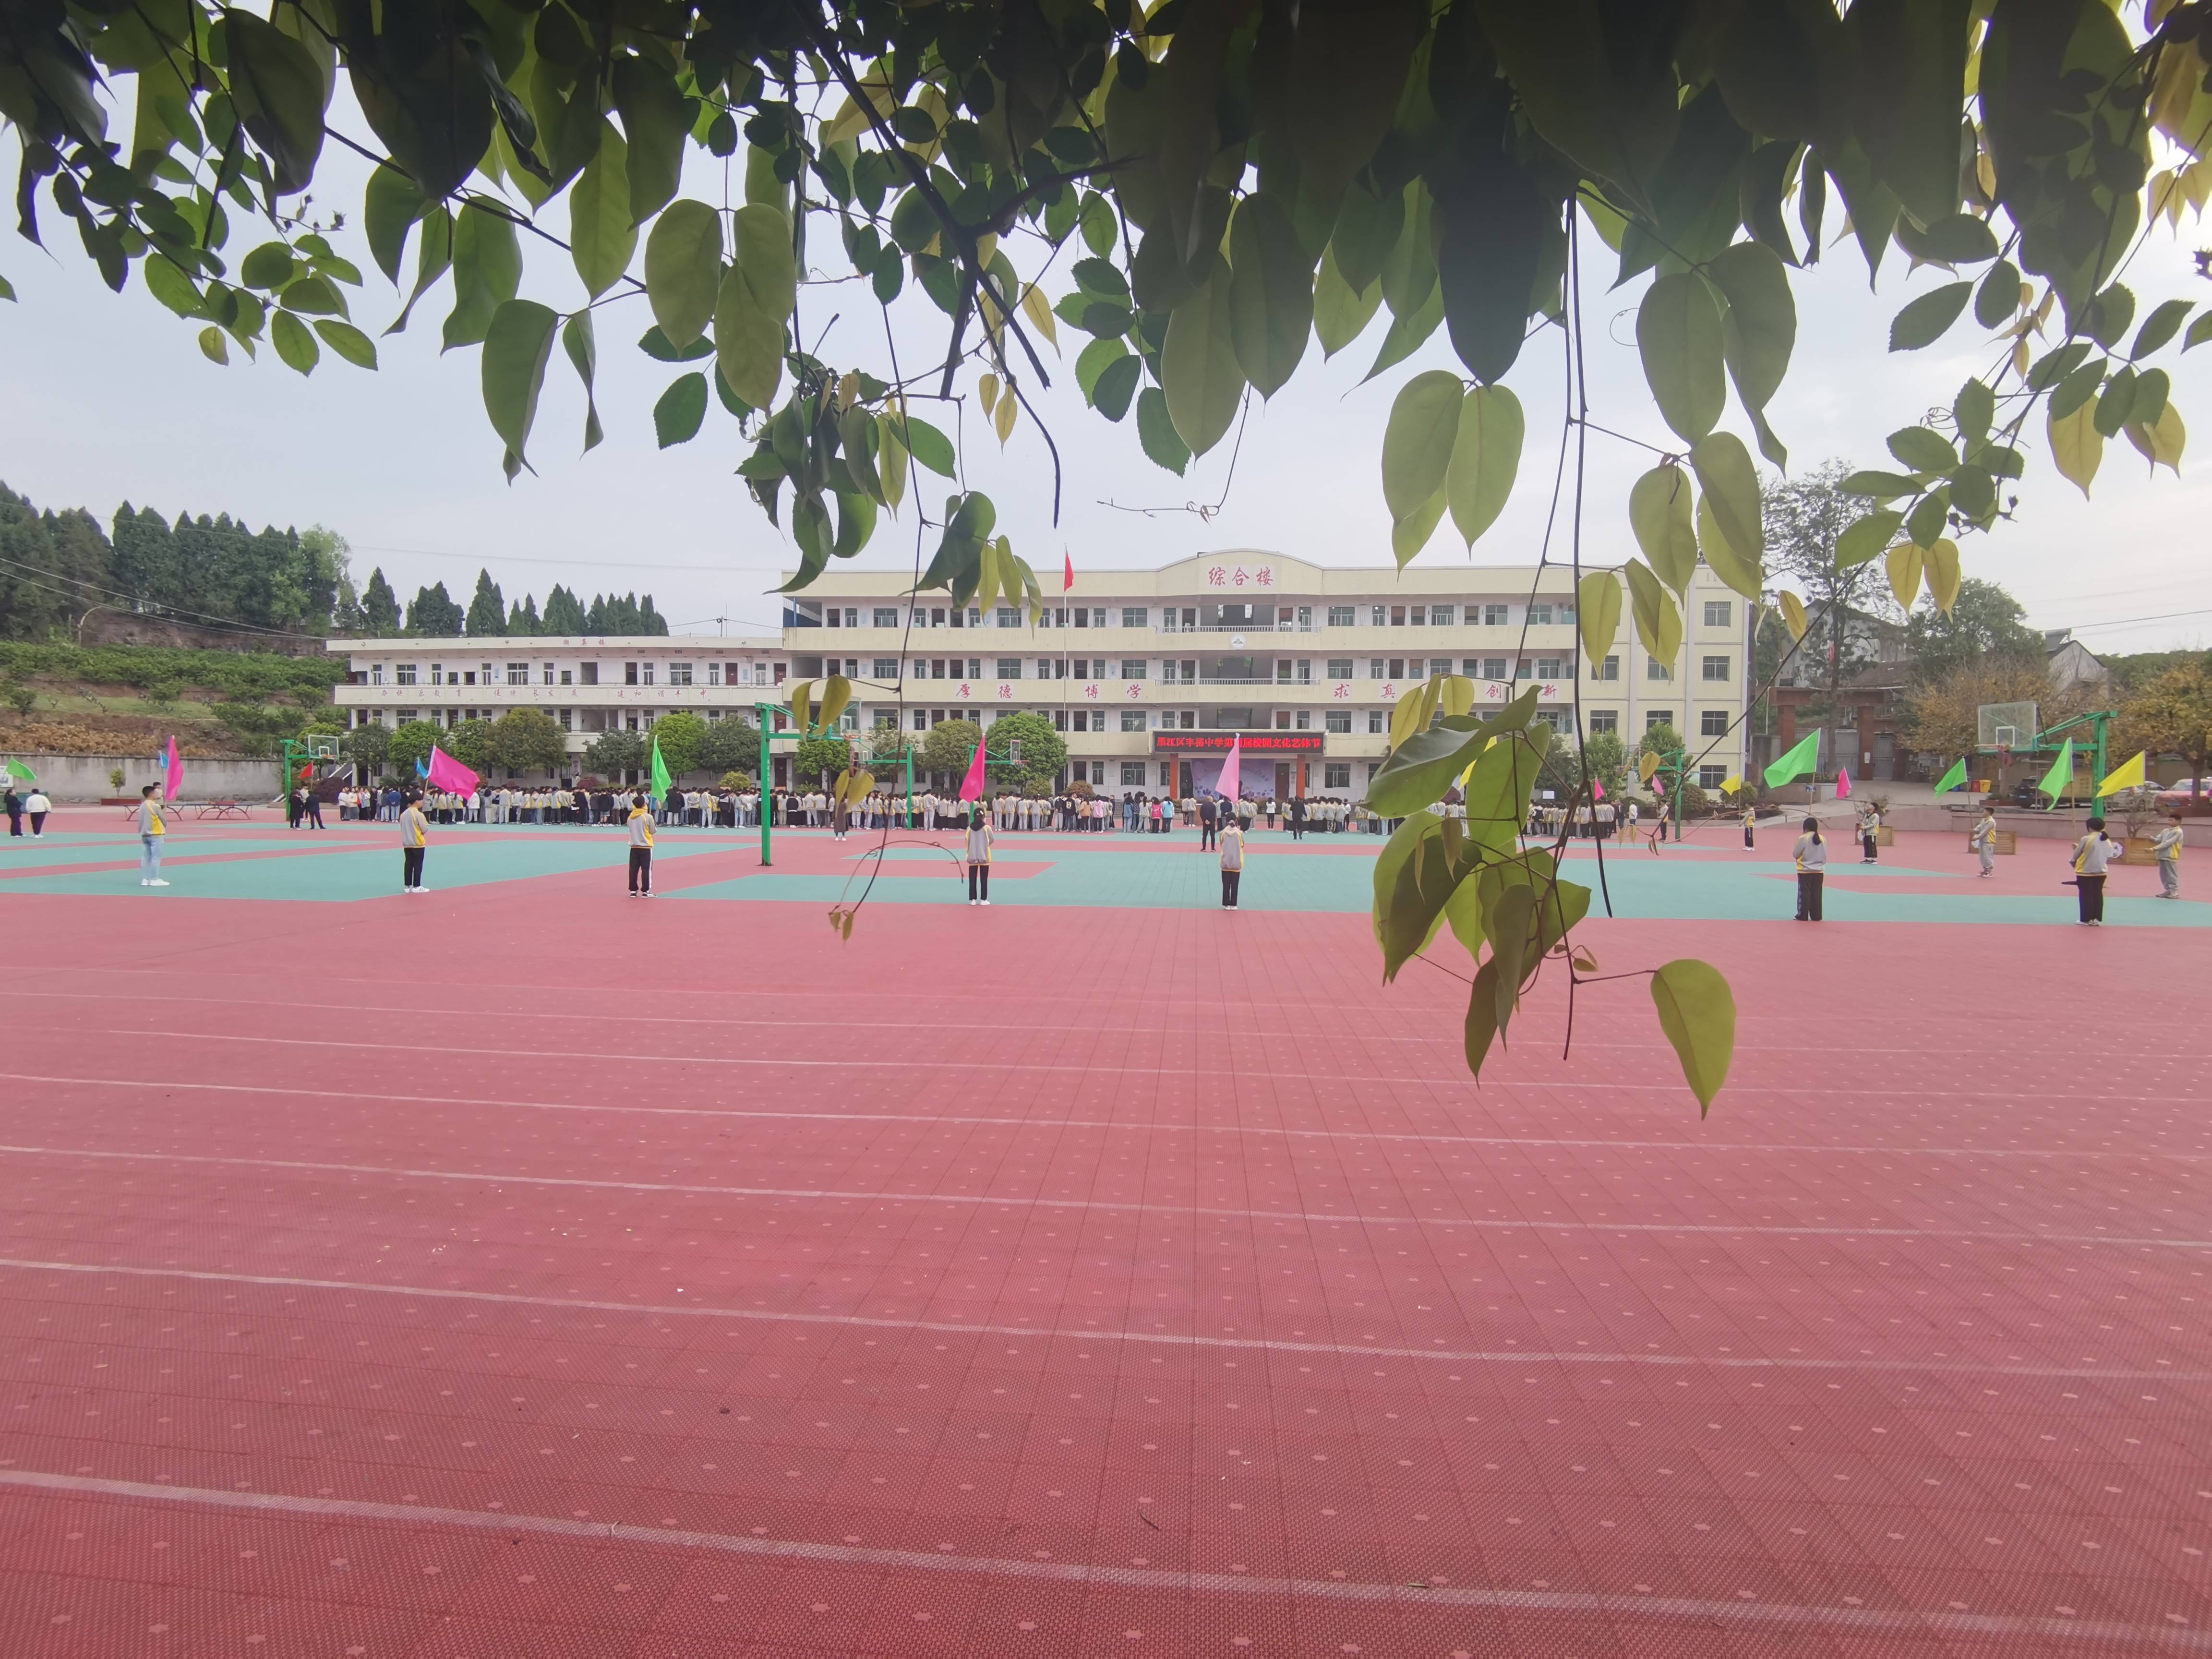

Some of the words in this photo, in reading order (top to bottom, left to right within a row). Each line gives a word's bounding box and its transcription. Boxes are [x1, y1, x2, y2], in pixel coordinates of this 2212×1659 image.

[1208, 566, 1273, 586] 综合楼
[956, 684, 1012, 698] 厚德
[1085, 684, 1141, 698] 博学
[1334, 684, 1395, 698] 求真
[1486, 684, 1557, 699] 创新
